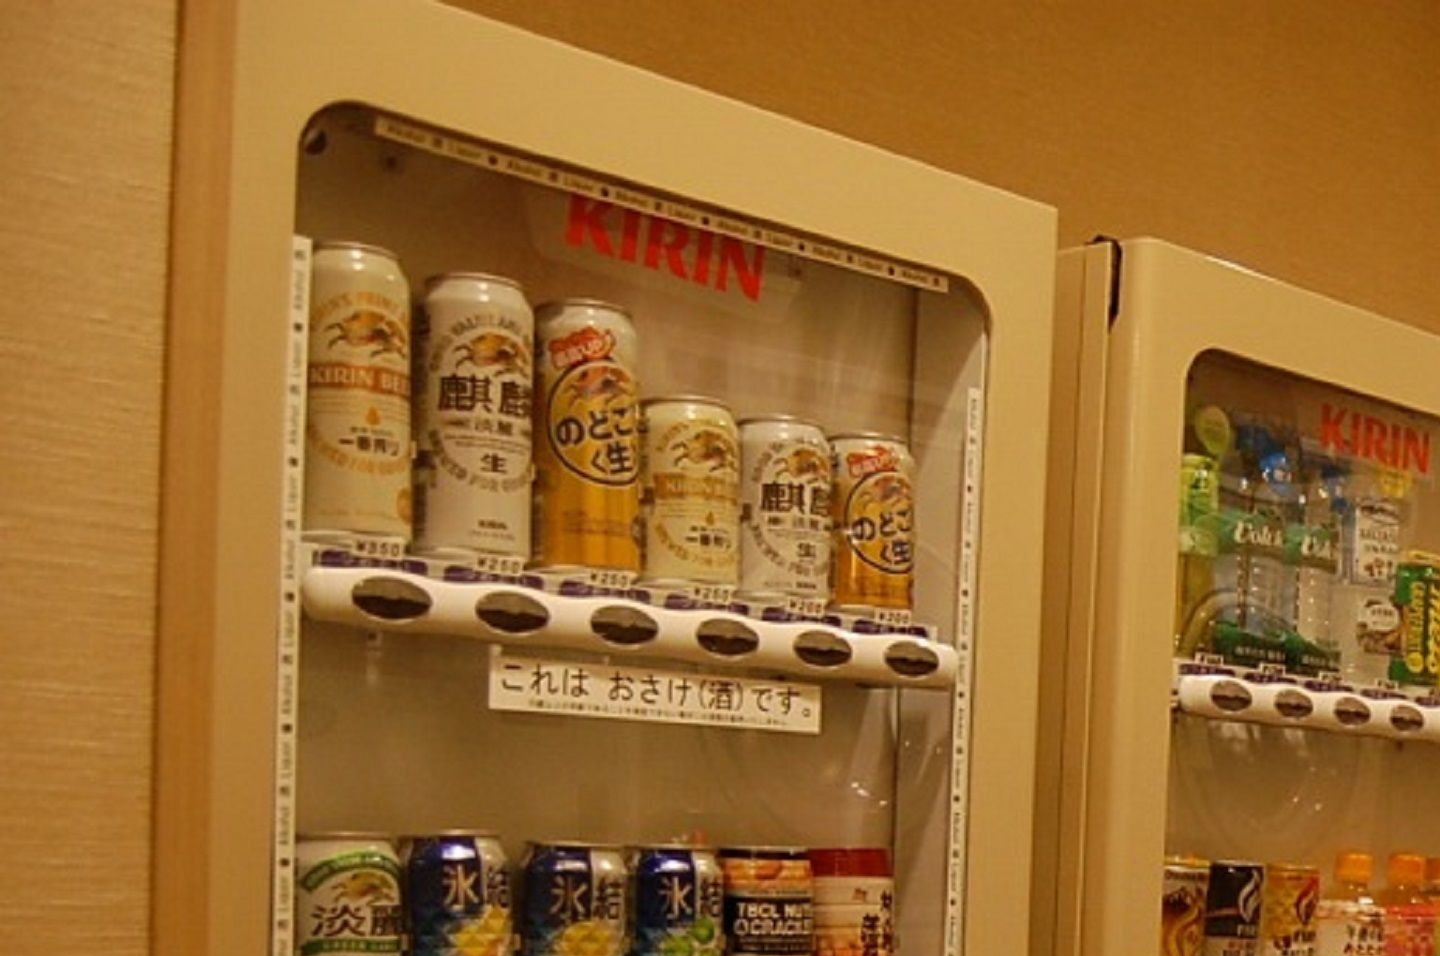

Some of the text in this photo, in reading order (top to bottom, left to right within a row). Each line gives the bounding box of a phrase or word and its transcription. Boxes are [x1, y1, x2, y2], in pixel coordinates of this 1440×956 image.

[564, 194, 768, 303] KIRIN
[310, 366, 374, 387] KIRIN
[1318, 403, 1432, 475] KIRIN
[502, 663, 589, 697] これは
